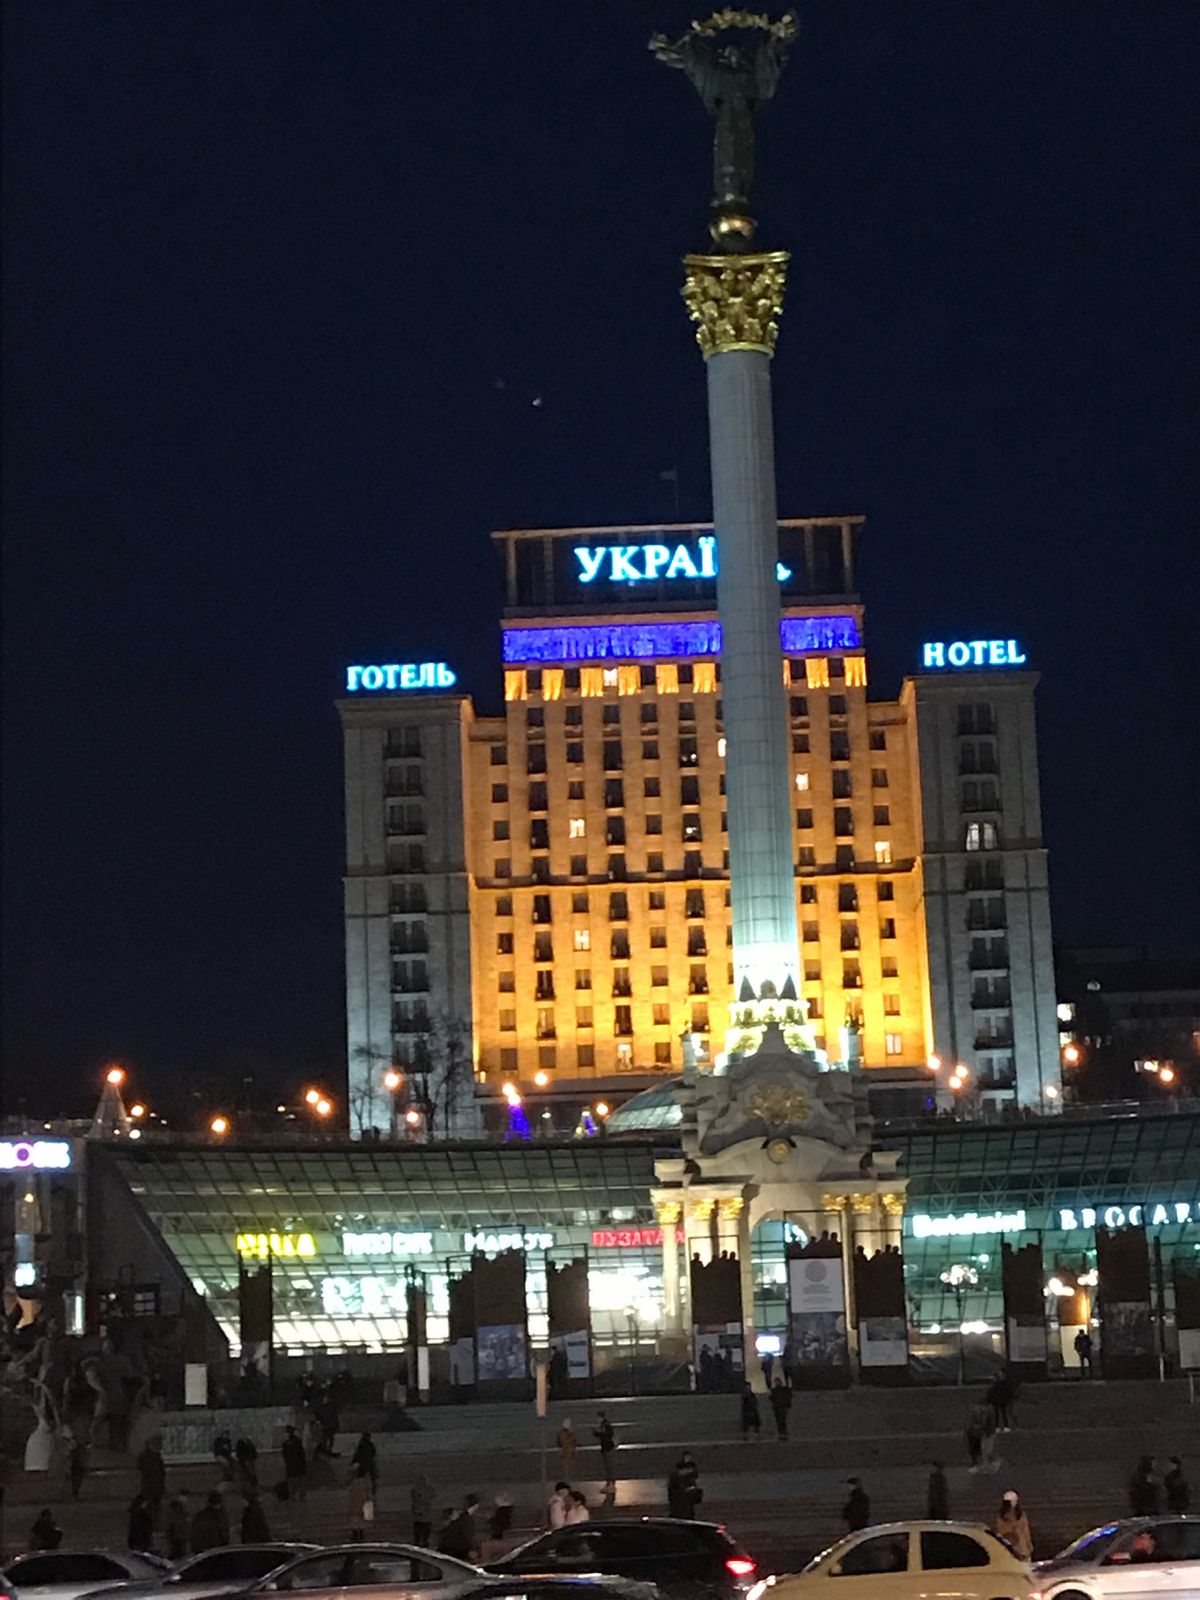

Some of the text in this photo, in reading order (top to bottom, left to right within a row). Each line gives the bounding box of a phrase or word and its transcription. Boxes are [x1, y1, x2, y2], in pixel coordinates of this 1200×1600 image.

[923, 639, 1026, 667] HOTEL
[346, 661, 456, 692] ГОТЕЛЬ
[1059, 1203, 1200, 1231] BROCAR
